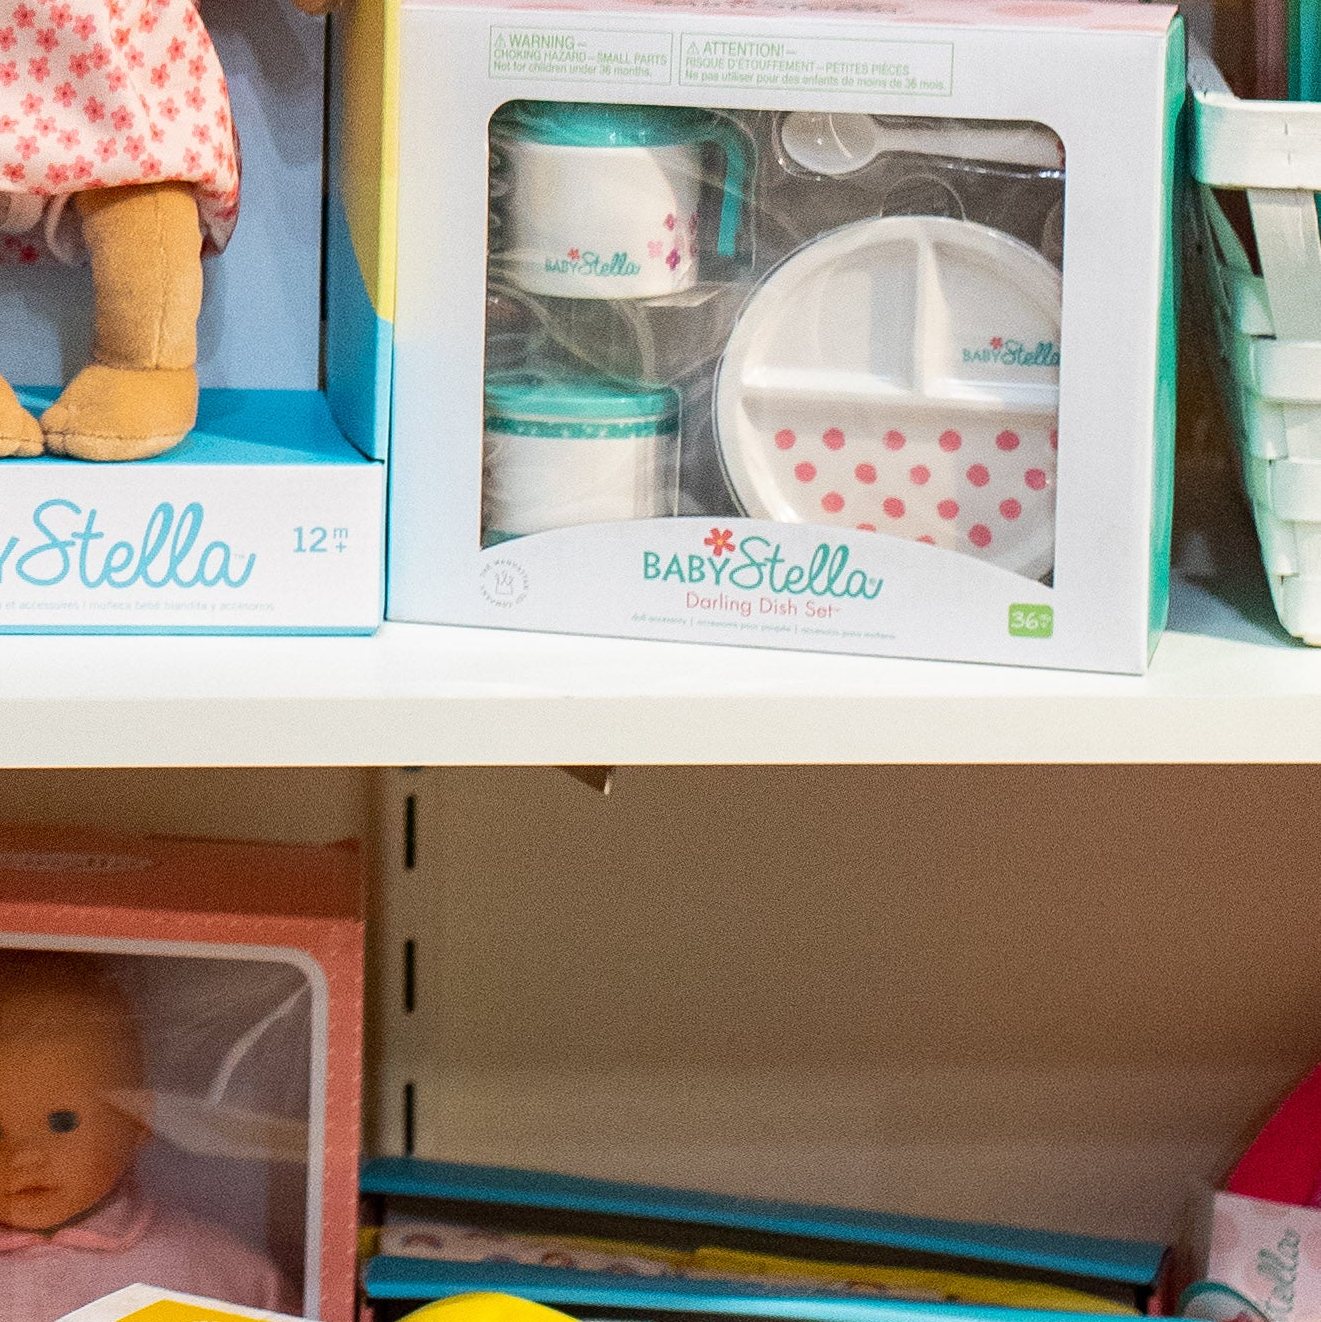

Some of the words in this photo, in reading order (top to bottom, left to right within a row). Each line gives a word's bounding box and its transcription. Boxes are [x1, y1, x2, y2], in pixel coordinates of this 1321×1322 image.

[509, 34, 575, 49] WARNING
[703, 41, 784, 58] ATTENTION!
[494, 49, 541, 60] CHOKING
[544, 50, 586, 62] HAZARD
[597, 52, 630, 64] SMALL
[634, 54, 667, 66] PARTS
[685, 57, 724, 70] RISQUE
[826, 62, 868, 75] PETITES
[686, 591, 751, 617] Darling
[760, 597, 797, 616] Dish
